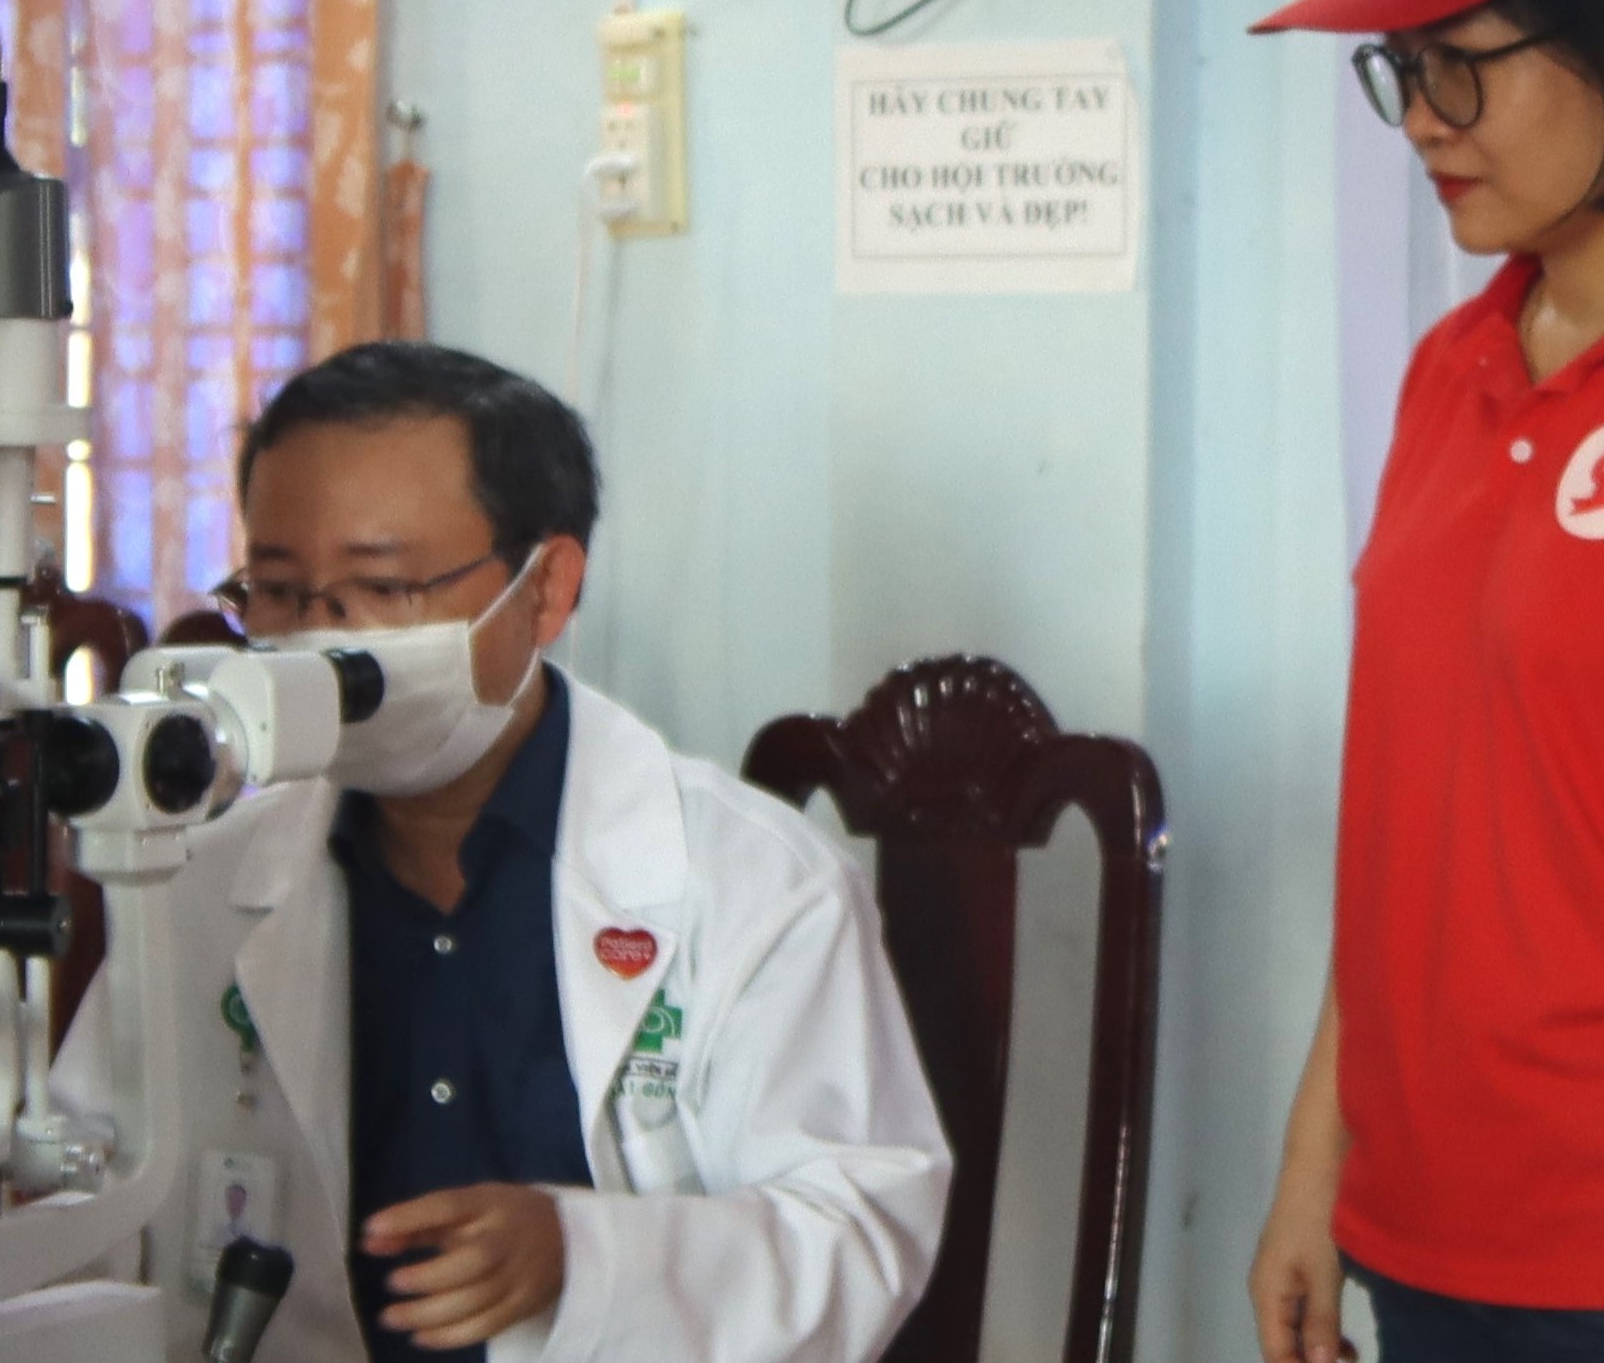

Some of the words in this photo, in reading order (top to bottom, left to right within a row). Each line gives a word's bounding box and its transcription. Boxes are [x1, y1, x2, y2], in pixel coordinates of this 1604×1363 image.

[937, 87, 1043, 114] CHUNG
[1052, 85, 1110, 112] TAY
[858, 165, 923, 190] CHO
